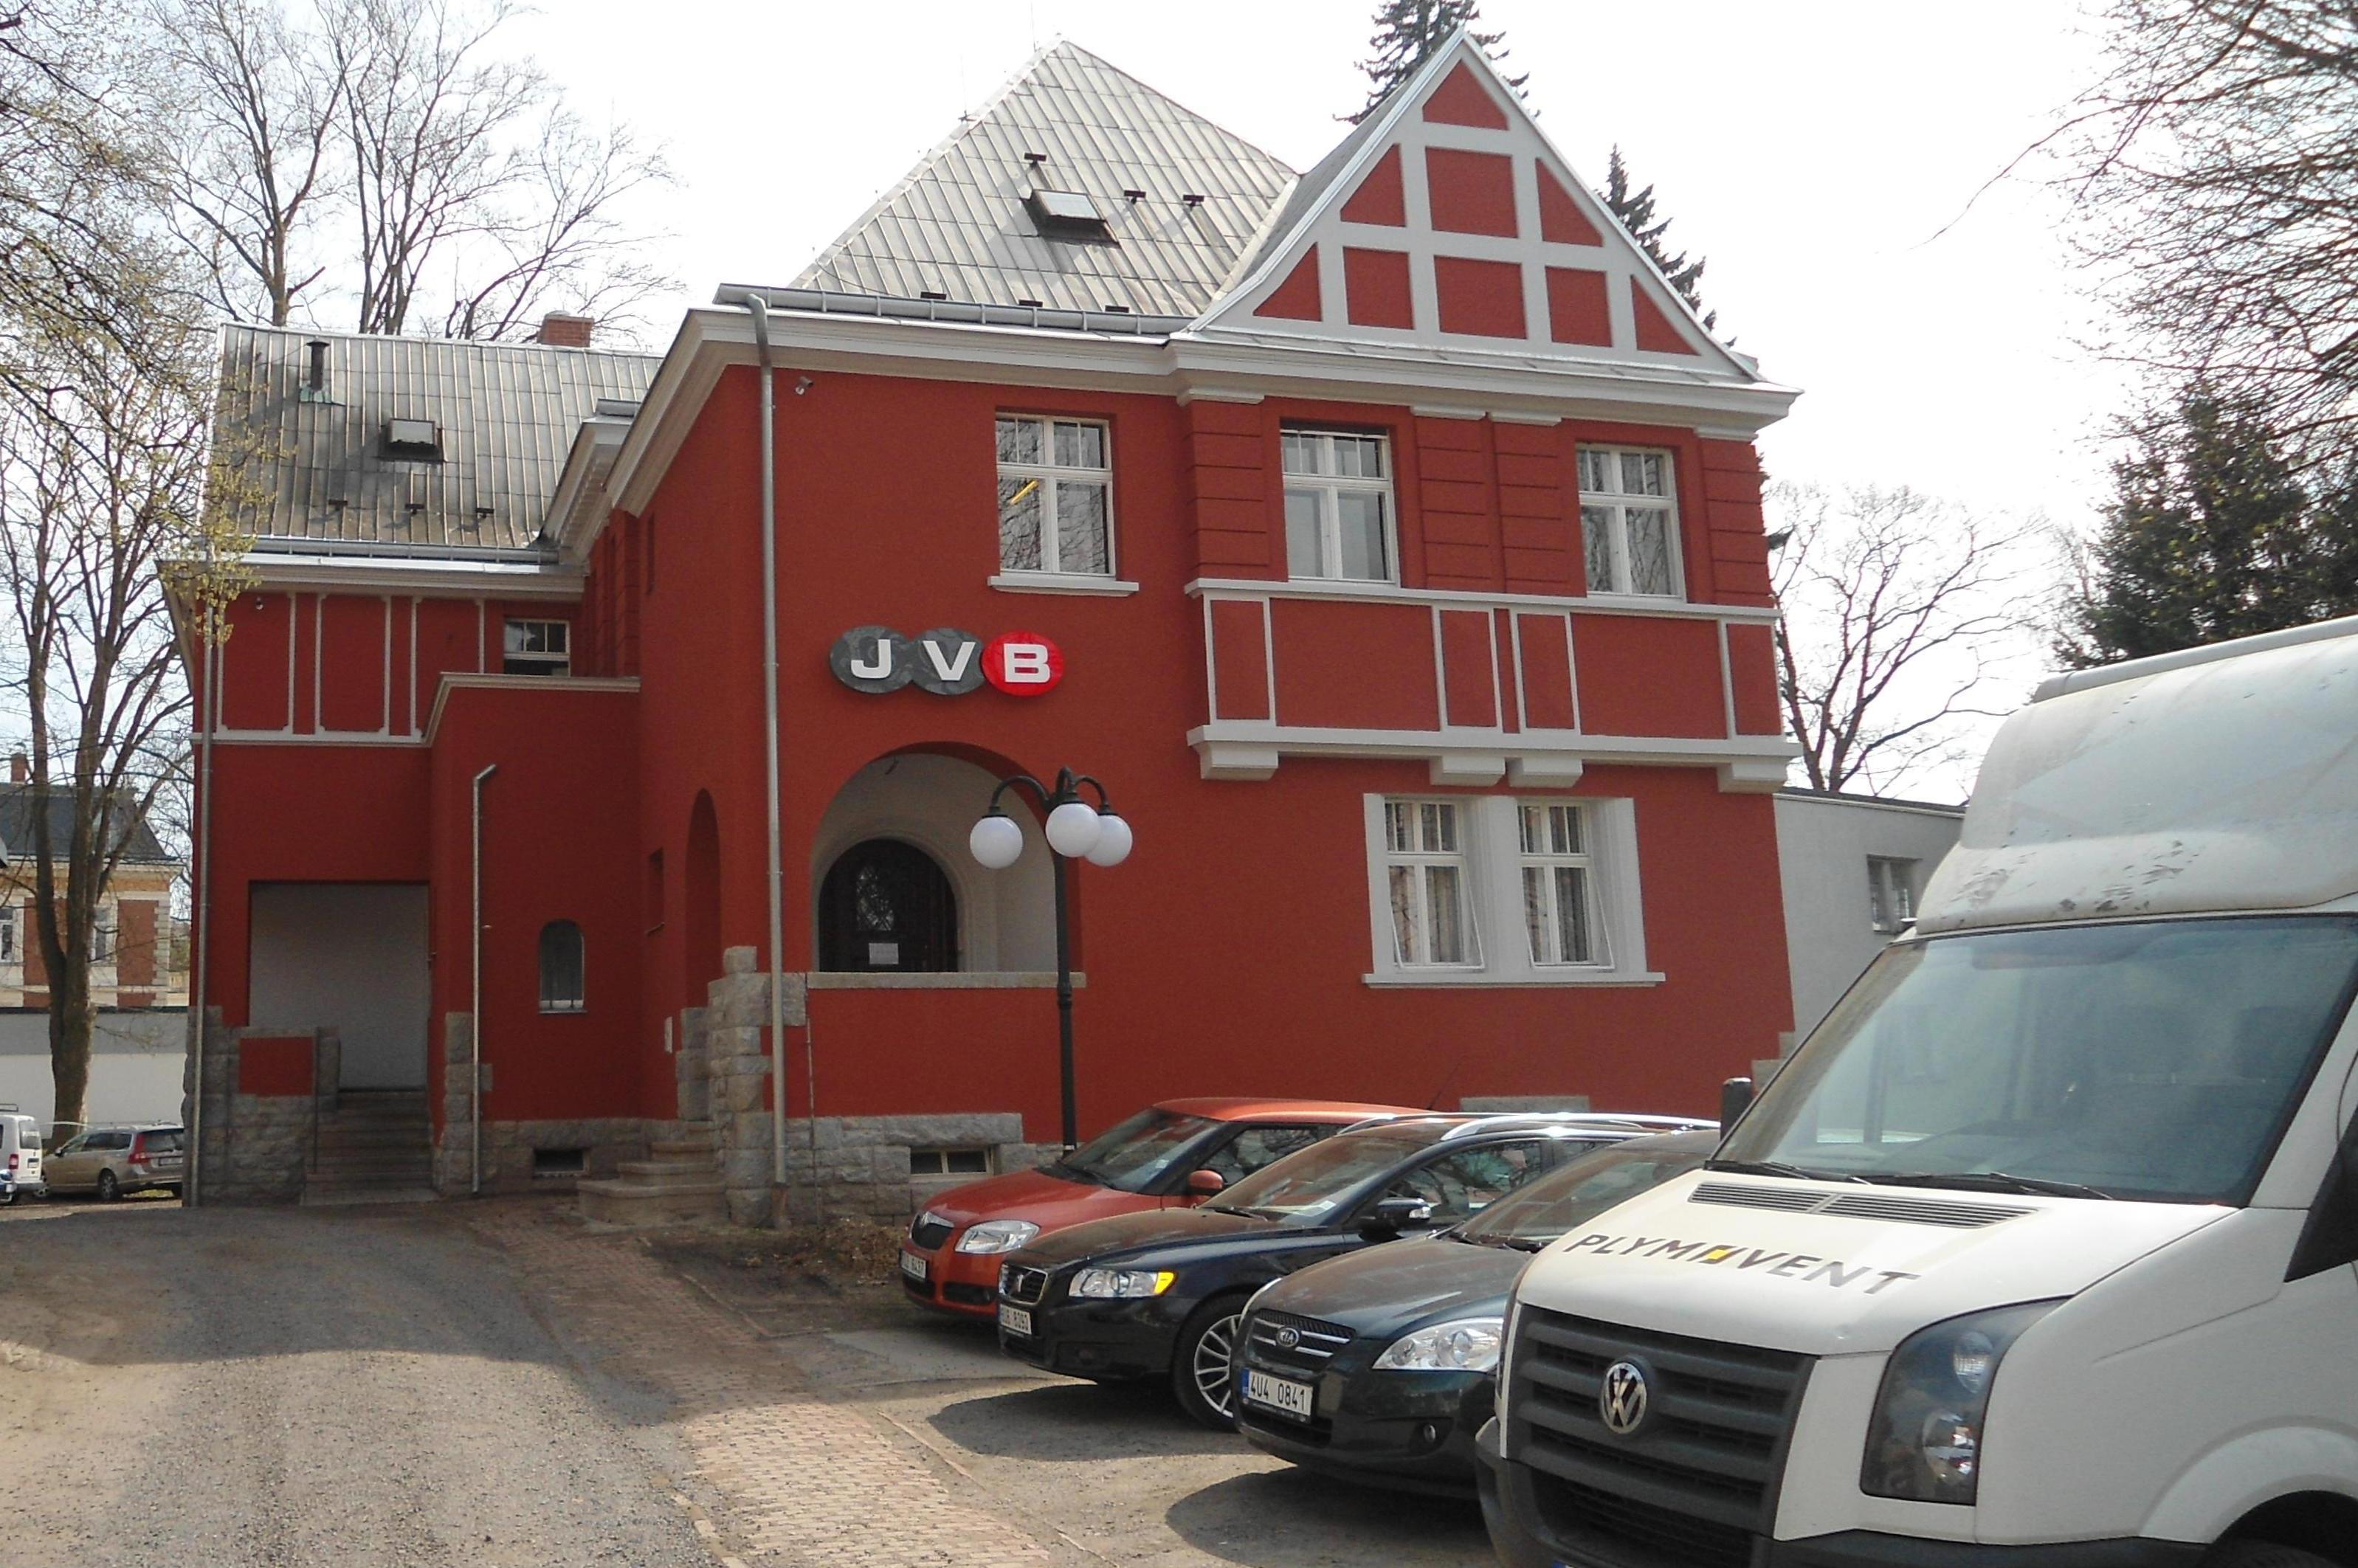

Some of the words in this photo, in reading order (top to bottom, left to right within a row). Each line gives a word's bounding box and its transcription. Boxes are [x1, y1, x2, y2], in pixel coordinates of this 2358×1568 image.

[1562, 1233, 1922, 1295] PLYMOVENT
[1251, 1375, 1269, 1400] 4U4
[1278, 1383, 1306, 1411] 0841
